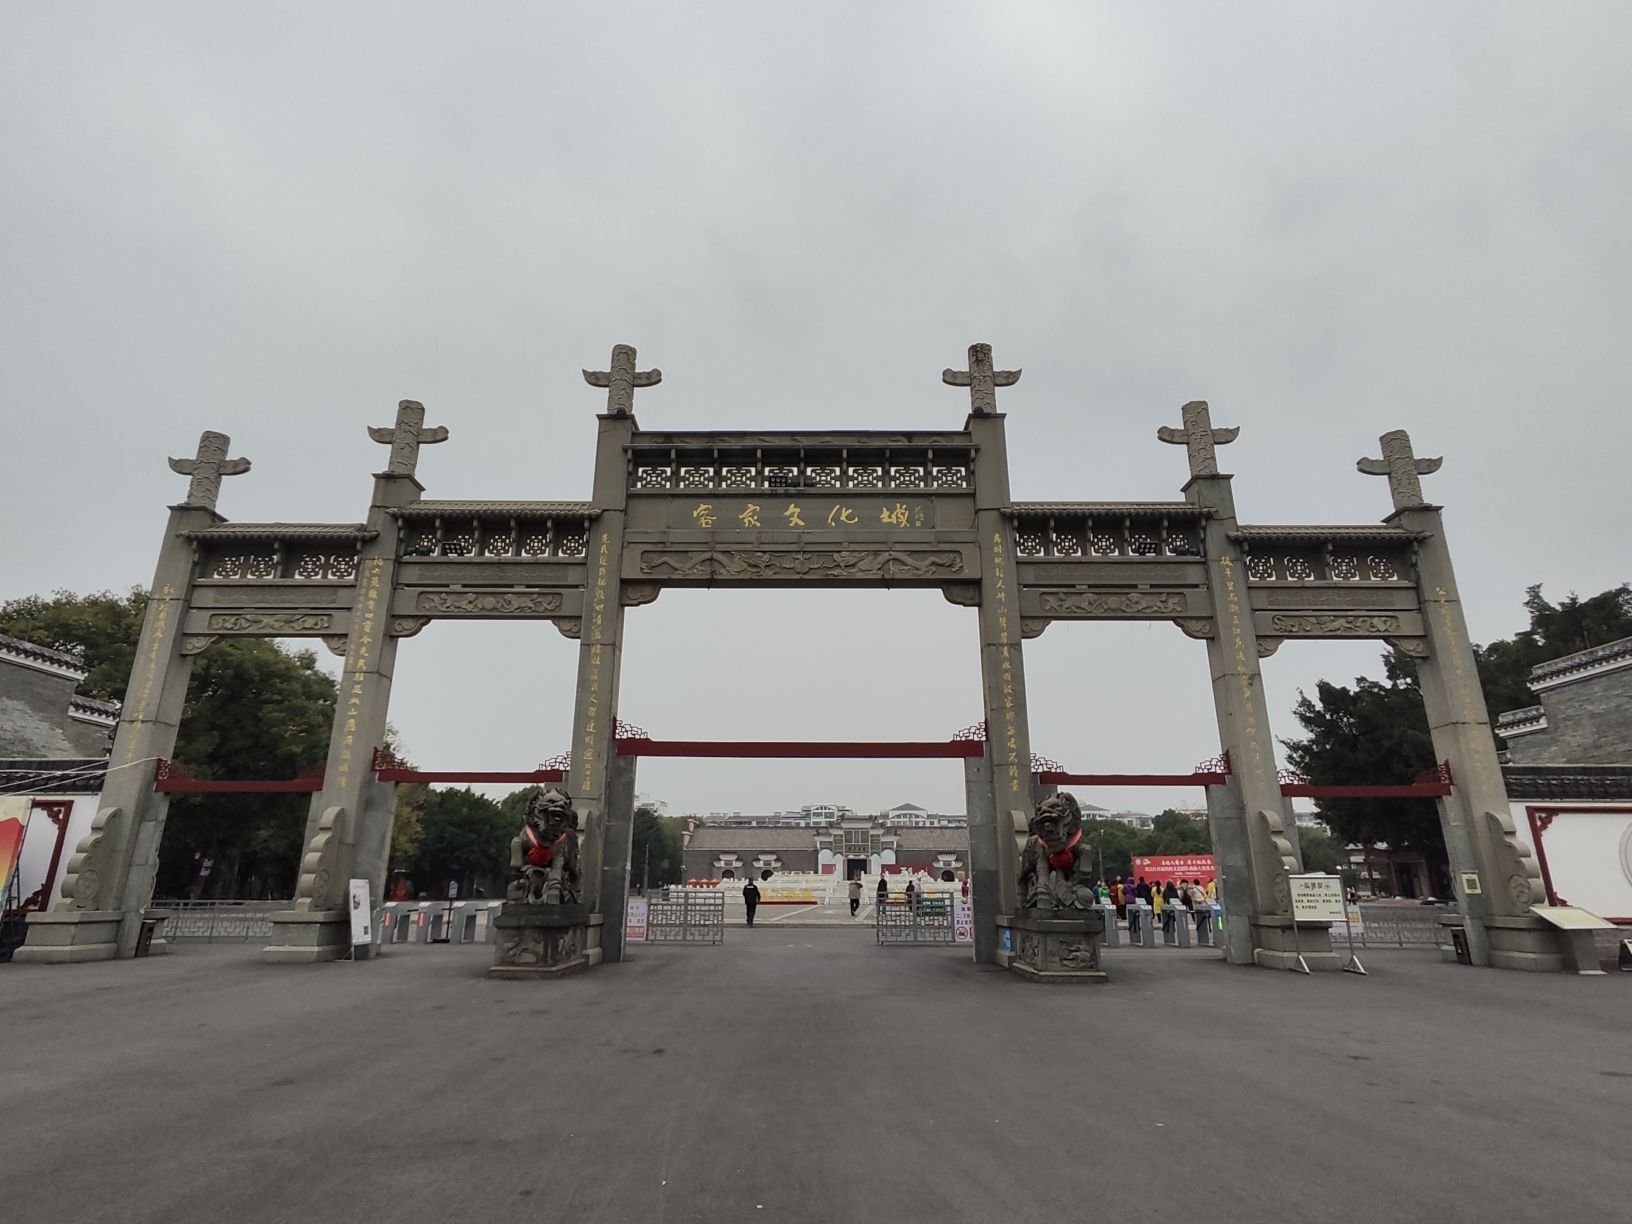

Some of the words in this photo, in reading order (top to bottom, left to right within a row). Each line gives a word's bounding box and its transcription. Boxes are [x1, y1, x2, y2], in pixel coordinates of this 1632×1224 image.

[693, 503, 911, 529] 客家文化城
